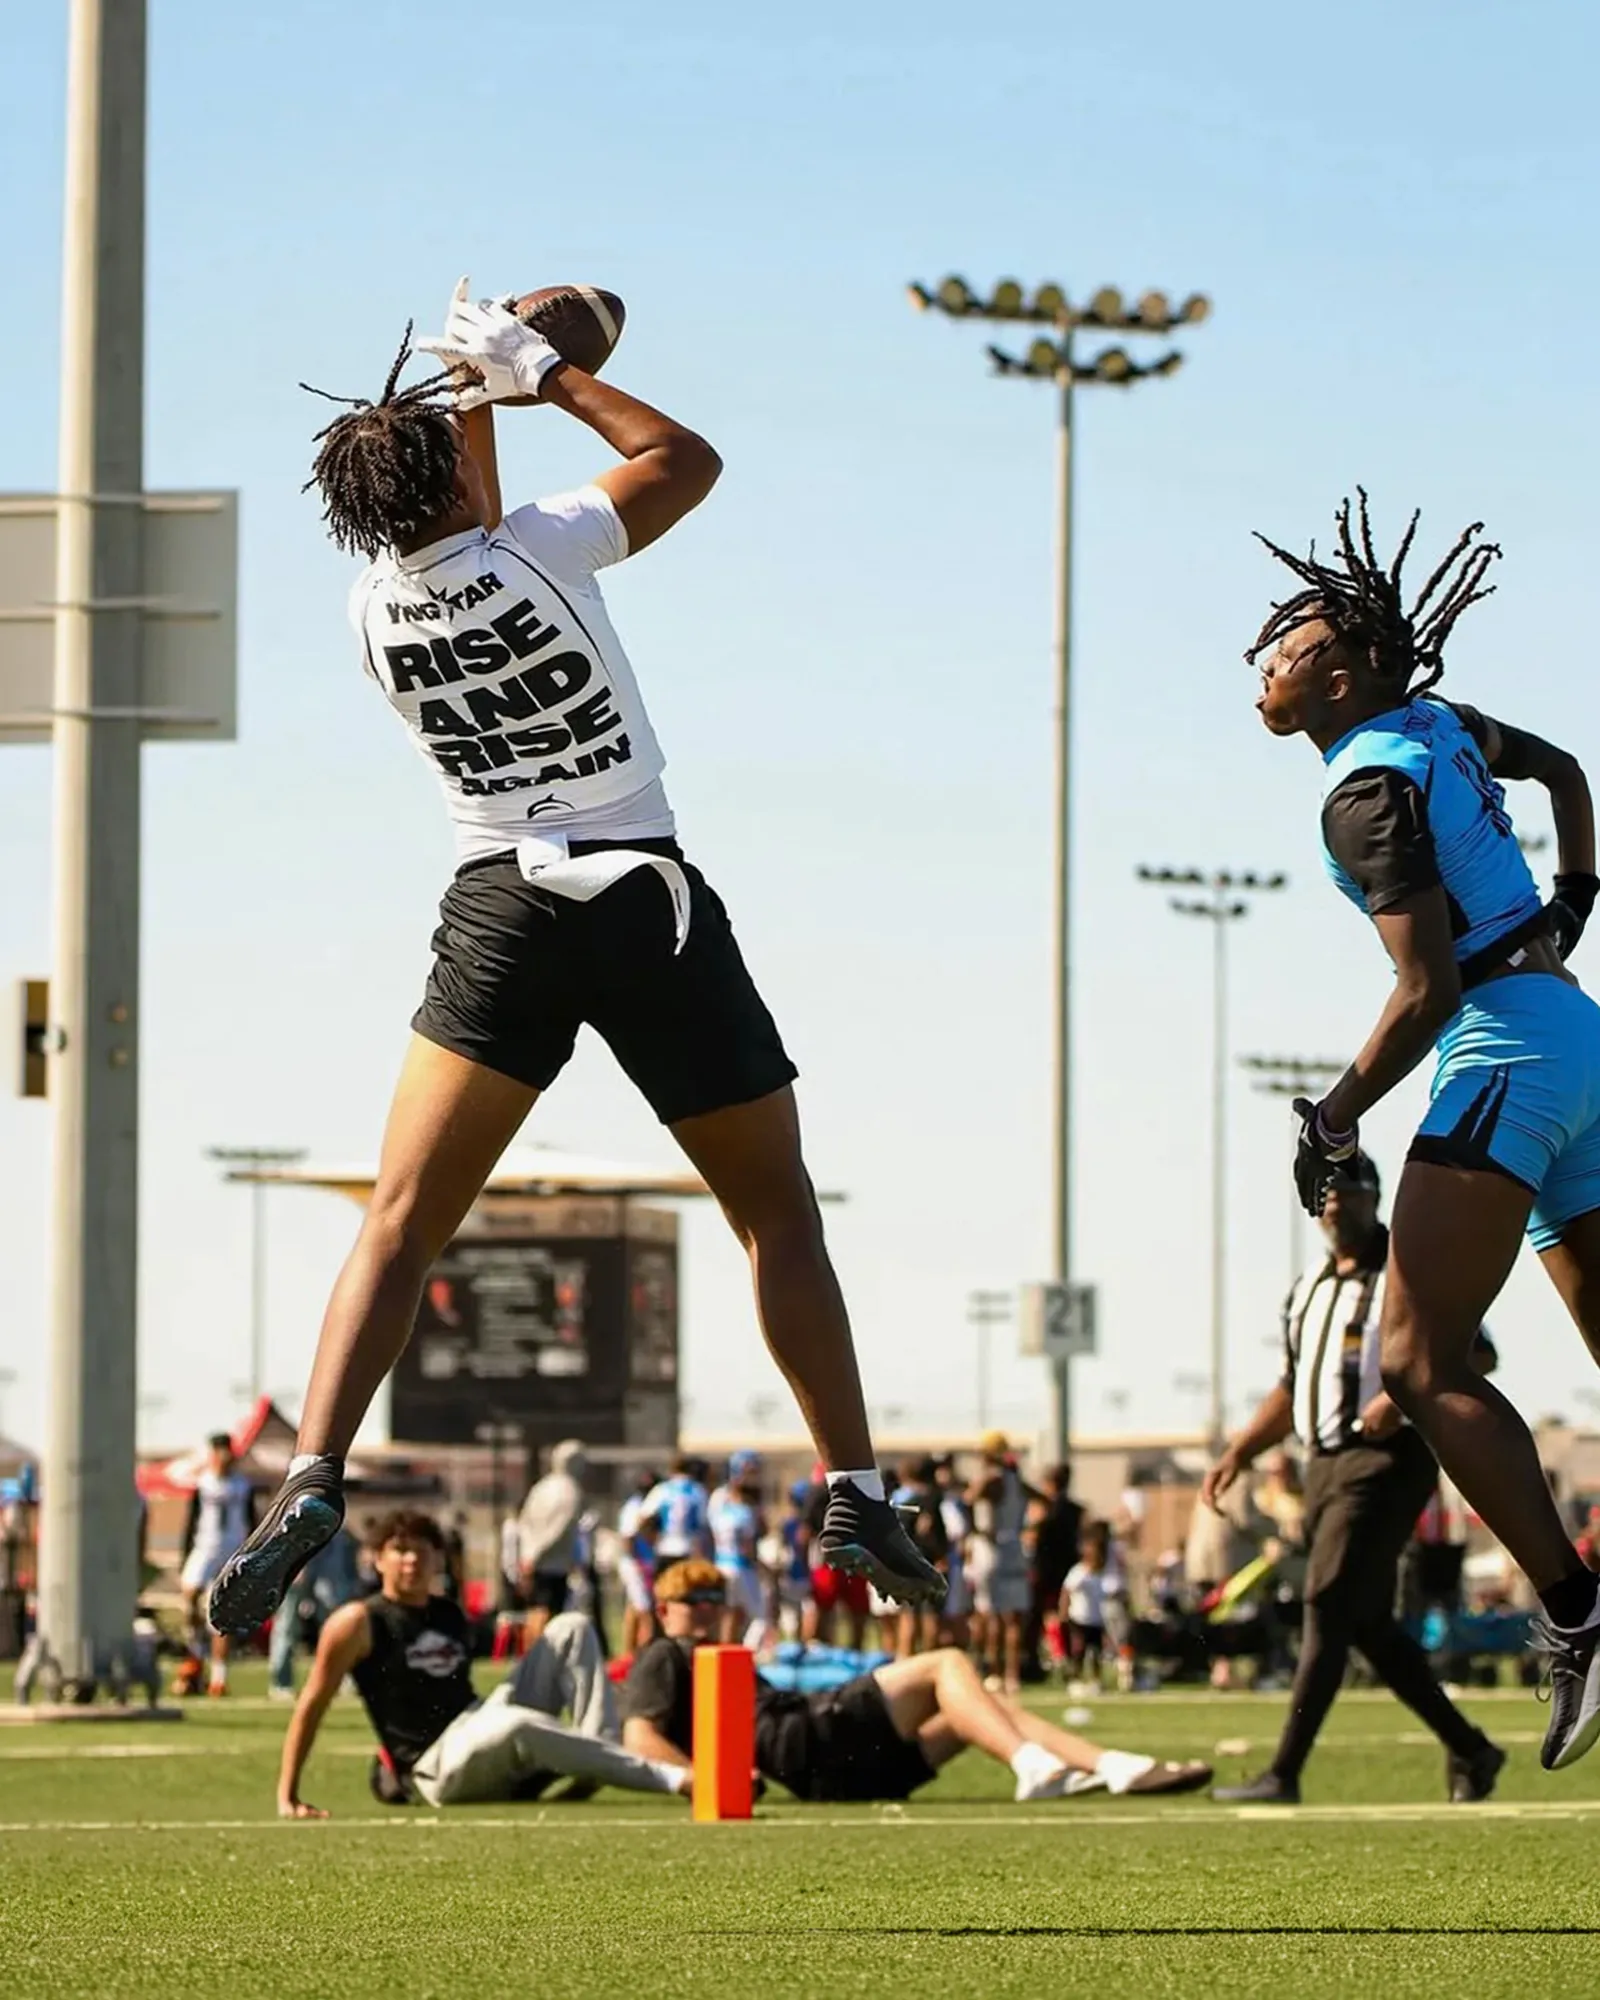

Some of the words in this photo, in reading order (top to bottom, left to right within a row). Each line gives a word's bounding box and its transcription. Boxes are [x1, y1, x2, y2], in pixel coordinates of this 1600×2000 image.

[383, 598, 561, 692] RISE
[420, 651, 591, 736] AND
[430, 686, 622, 775] RISE
[461, 732, 632, 796] AGAIN
[1045, 1286, 1095, 1338] 21
